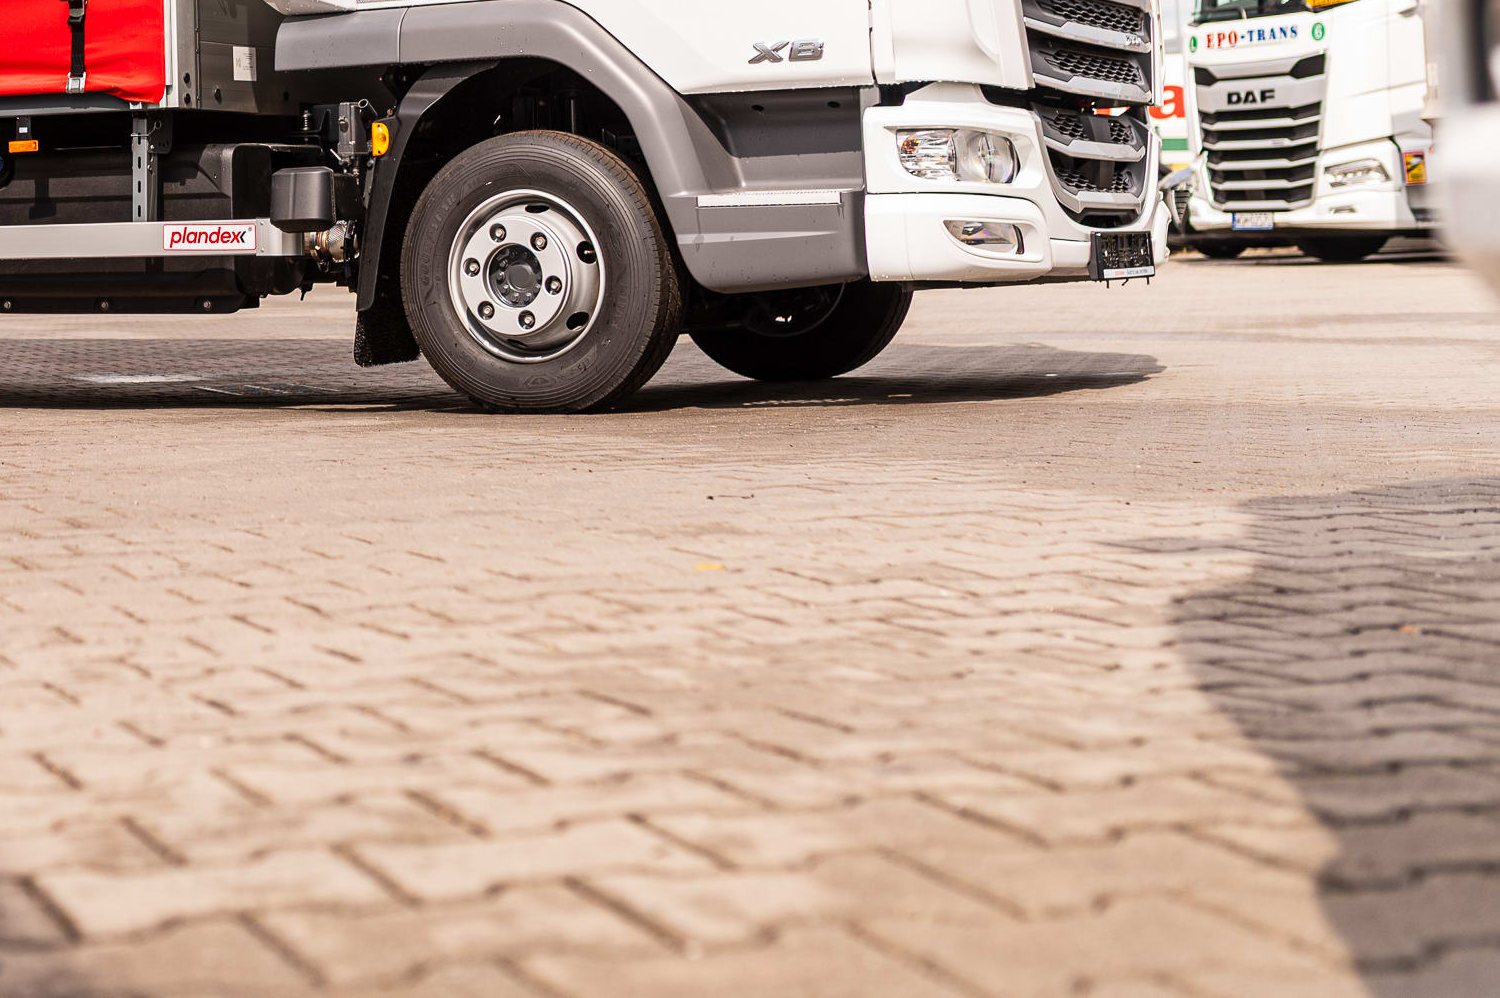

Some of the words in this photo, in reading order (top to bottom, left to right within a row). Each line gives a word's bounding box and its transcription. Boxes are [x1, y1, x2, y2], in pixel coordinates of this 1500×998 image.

[748, 41, 825, 64] XB
[1227, 89, 1276, 105] DAF
[170, 227, 242, 248] plandex
